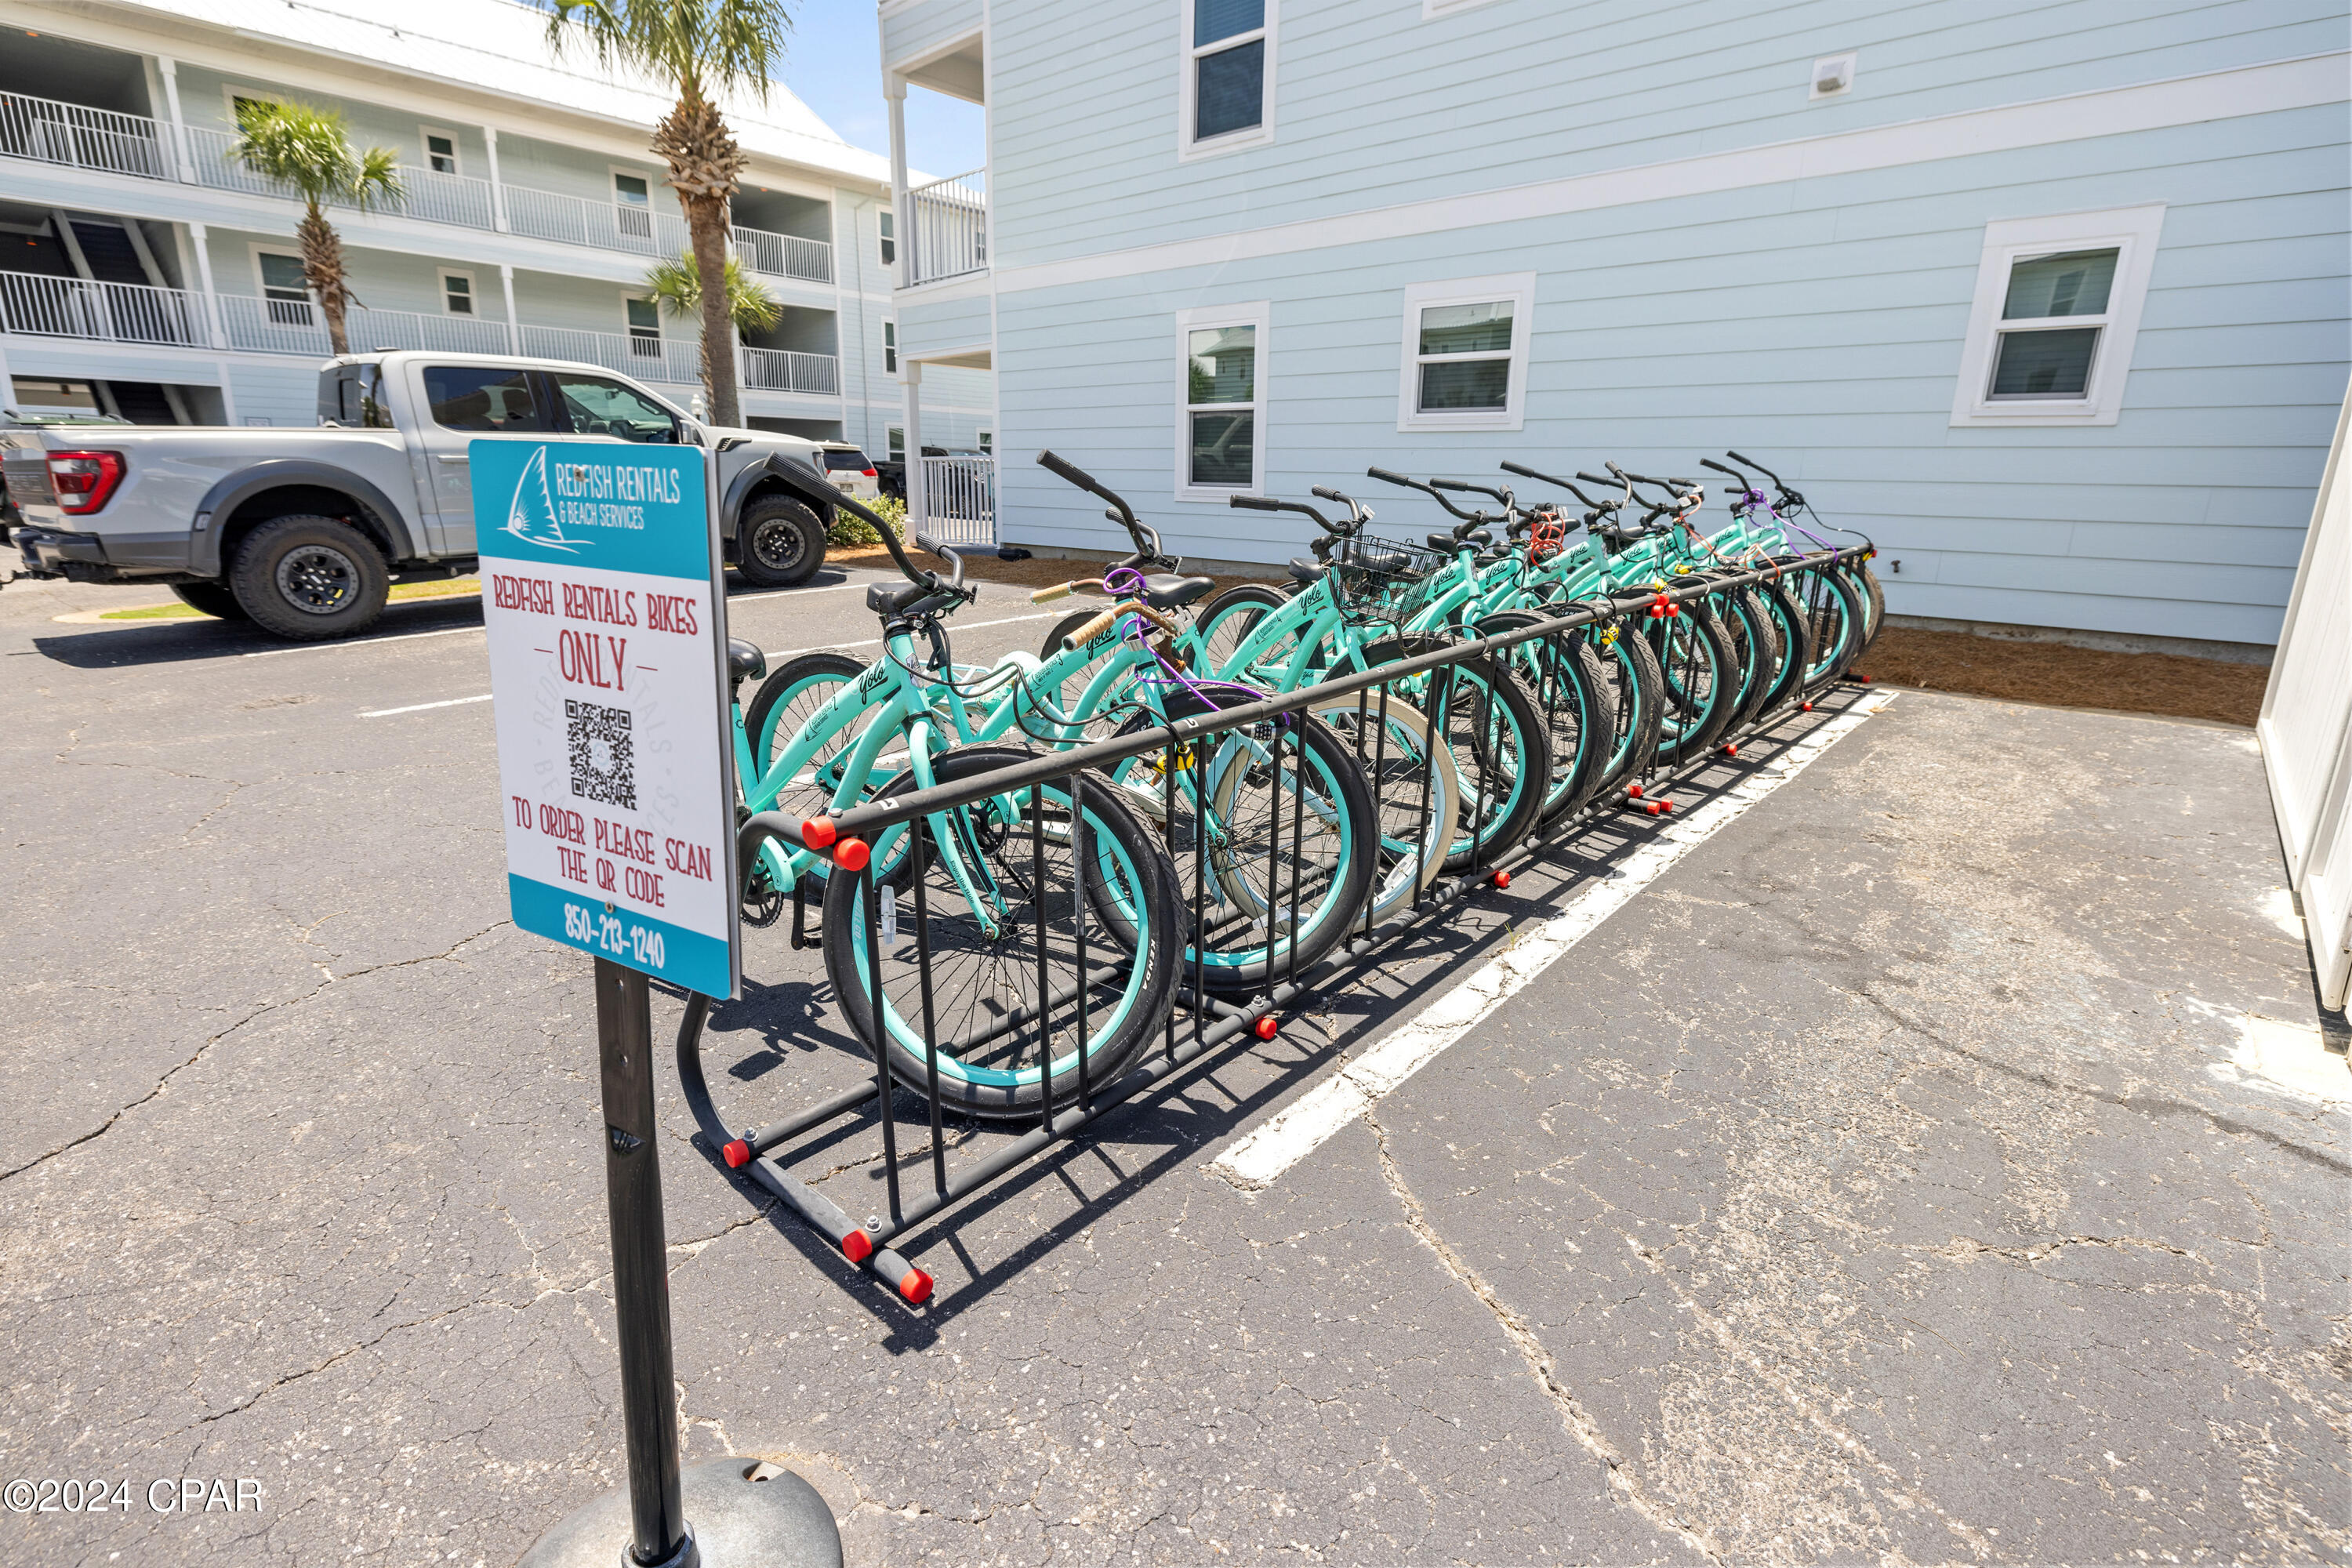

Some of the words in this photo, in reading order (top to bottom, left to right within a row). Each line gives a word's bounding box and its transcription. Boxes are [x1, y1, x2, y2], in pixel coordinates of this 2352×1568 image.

[555, 463, 613, 499] REDFISH
[615, 466, 681, 504] RENTALS
[559, 500, 566, 524] &
[567, 501, 598, 526] BEACH
[599, 503, 644, 530] SERVICES
[492, 573, 555, 616] REDFISH
[562, 583, 637, 627] RENTALS
[646, 593, 699, 636] BIKES
[1298, 584, 1324, 616] Yolo
[558, 629, 627, 691] ONLY
[858, 660, 889, 706] Yolo
[512, 795, 532, 829] TO
[539, 803, 586, 846] ORDER
[593, 817, 655, 866] PLEASE
[665, 837, 713, 883] SCAN
[557, 845, 588, 885] THE
[596, 858, 617, 893] QR
[626, 866, 666, 909] CODE
[950, 859, 961, 879] Enjoy
[964, 887, 975, 904] Ride
[564, 902, 666, 970] 850-213-1240
[1142, 938, 1156, 990] KENDA
